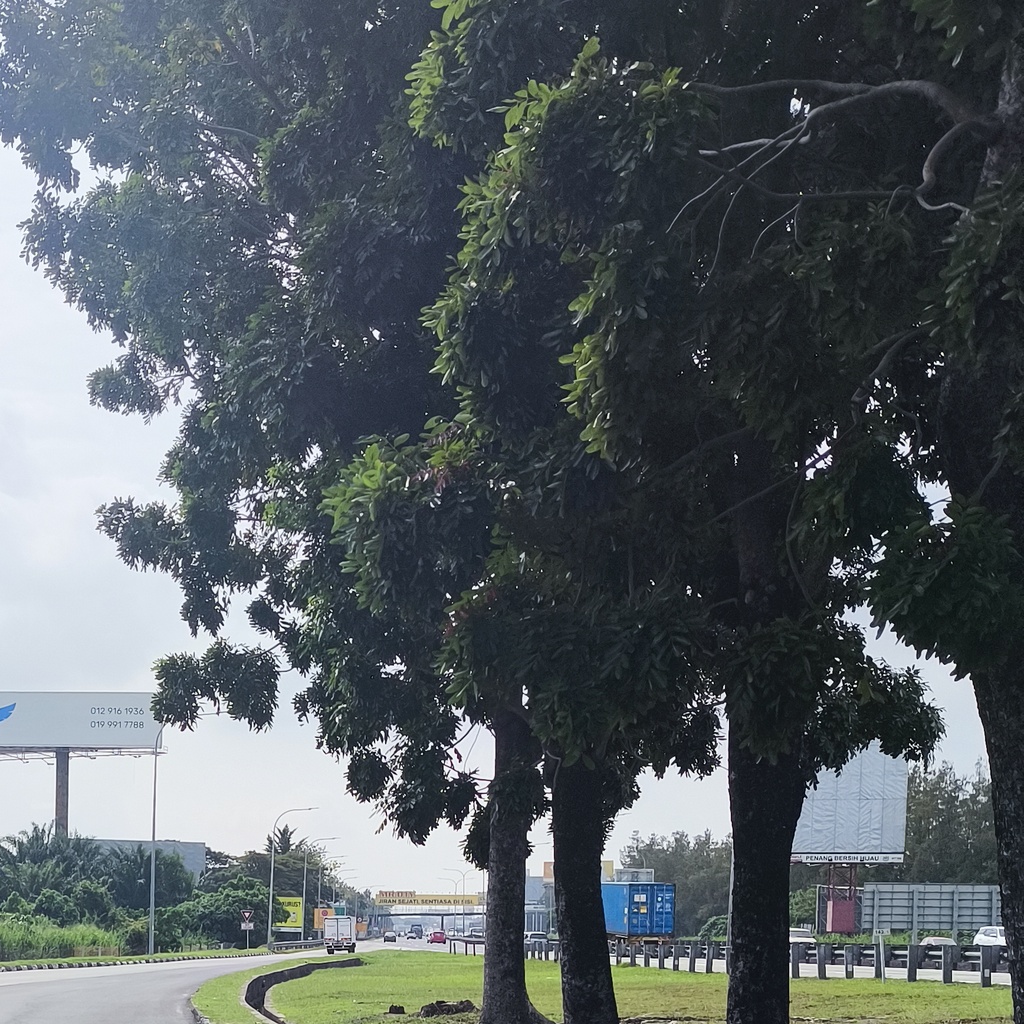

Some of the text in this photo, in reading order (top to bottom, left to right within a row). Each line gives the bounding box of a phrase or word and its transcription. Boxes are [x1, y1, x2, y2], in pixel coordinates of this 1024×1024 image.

[90, 706, 145, 715] 012 916 1936
[90, 720, 145, 729] 019 991 7788
